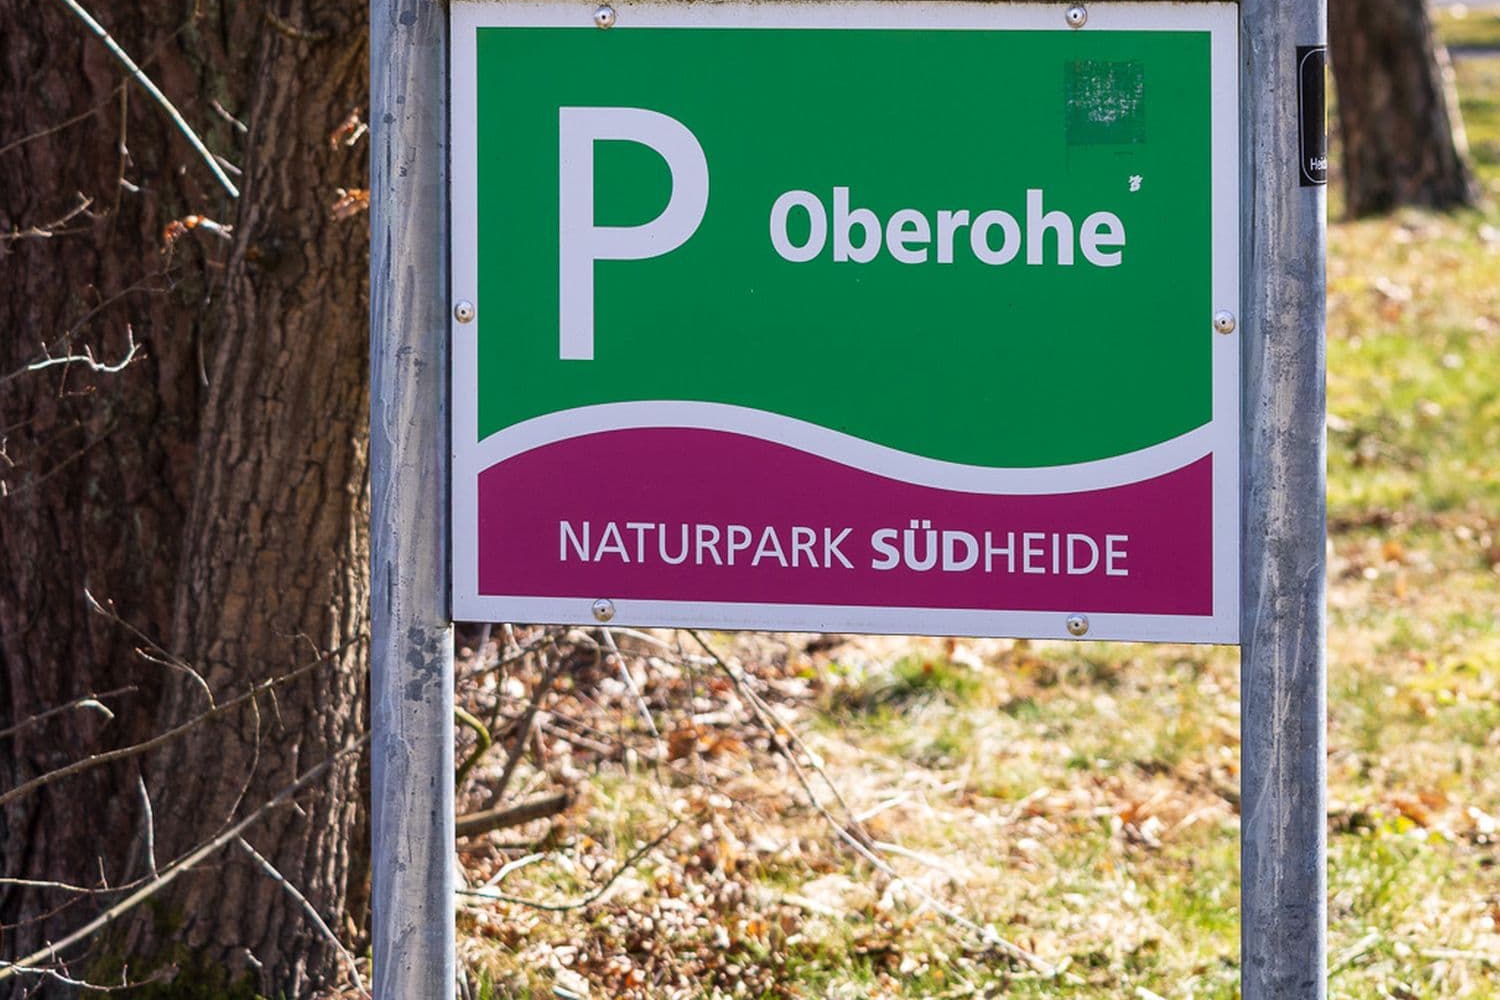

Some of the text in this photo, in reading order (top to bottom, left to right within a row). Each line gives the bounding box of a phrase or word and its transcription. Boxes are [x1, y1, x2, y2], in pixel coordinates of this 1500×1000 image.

[558, 106, 710, 361] P
[769, 186, 1126, 267] Oberohe
[559, 518, 1130, 577] NATURPARK SÜDHEIDE
